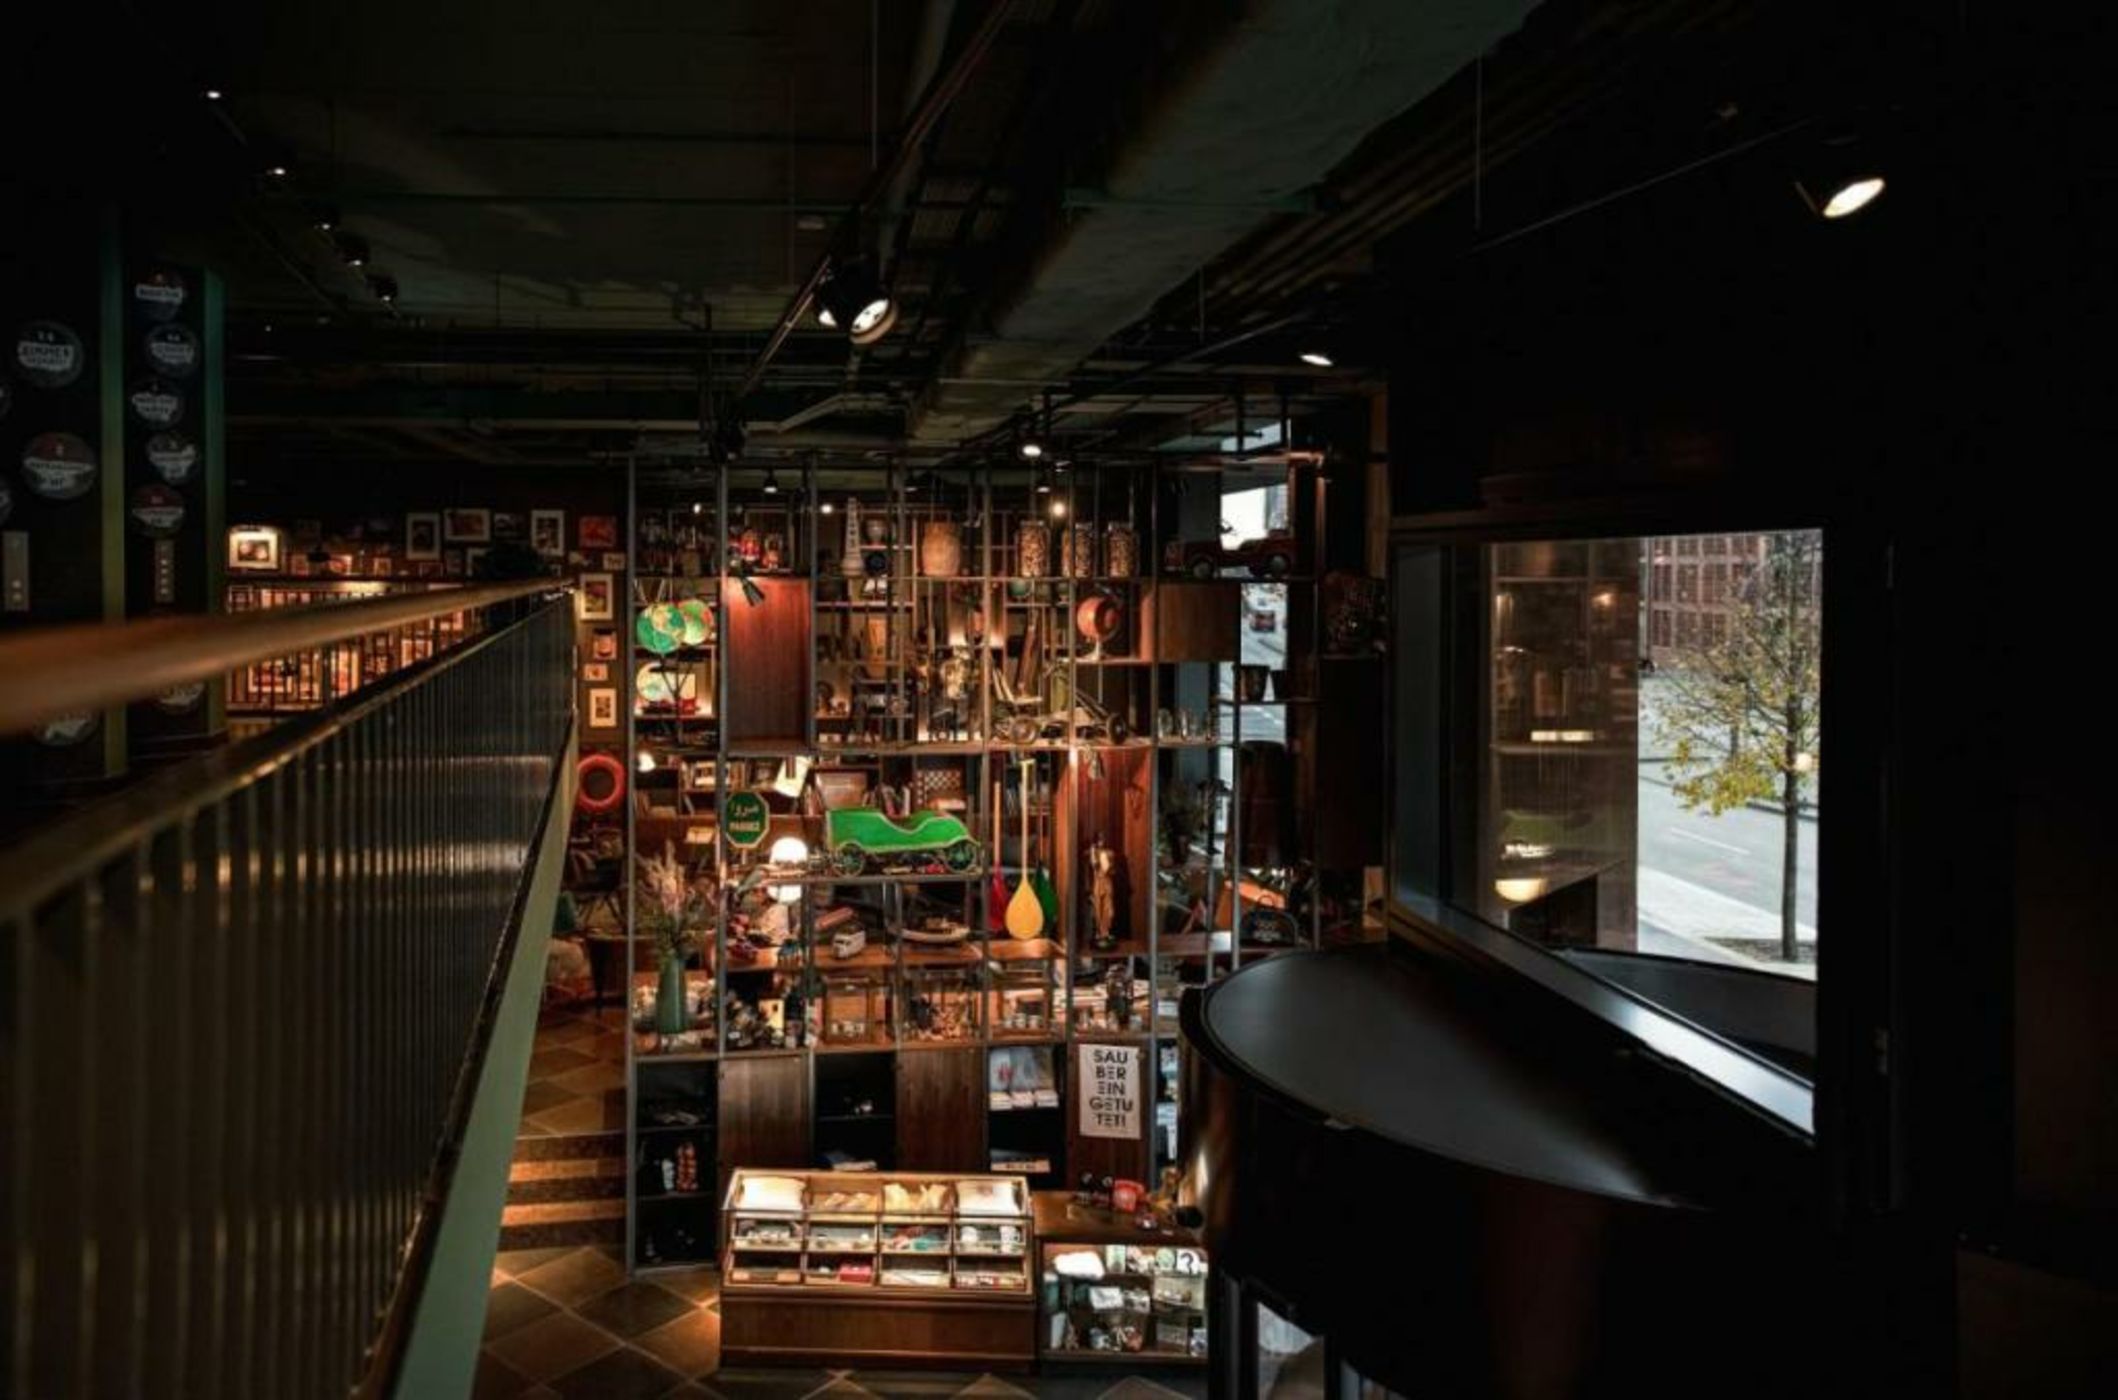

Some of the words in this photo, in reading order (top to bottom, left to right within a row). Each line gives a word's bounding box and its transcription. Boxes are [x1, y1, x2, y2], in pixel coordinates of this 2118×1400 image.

[1093, 1049, 1128, 1064] SAU
[1096, 1065, 1126, 1080] BER
[1097, 1081, 1125, 1095] EIN
